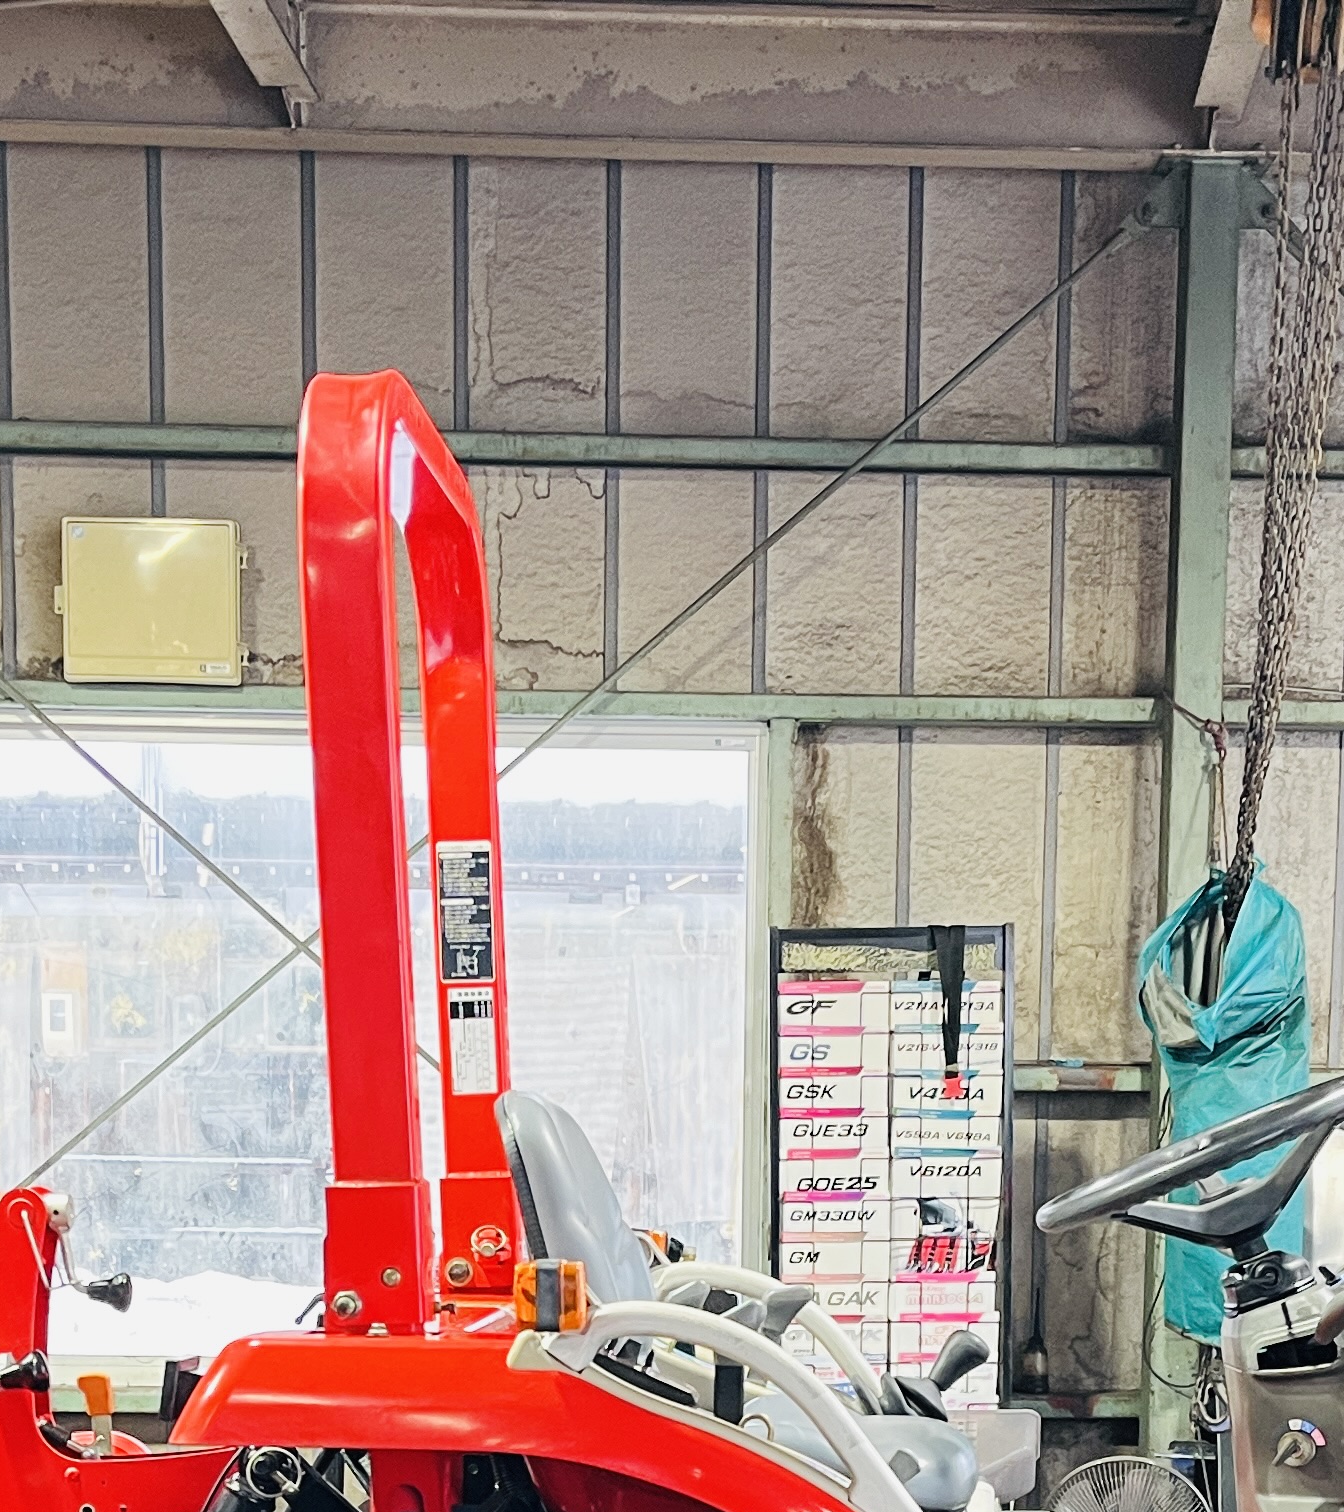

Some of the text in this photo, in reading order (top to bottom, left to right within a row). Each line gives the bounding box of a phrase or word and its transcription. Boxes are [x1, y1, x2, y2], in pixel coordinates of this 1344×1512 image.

[786, 999, 838, 1016] GF
[789, 1043, 831, 1061] GS
[786, 1084, 837, 1100] GSK
[792, 1123, 869, 1138] GJE33
[788, 1251, 821, 1265] GM
[827, 1290, 880, 1306] GAK
